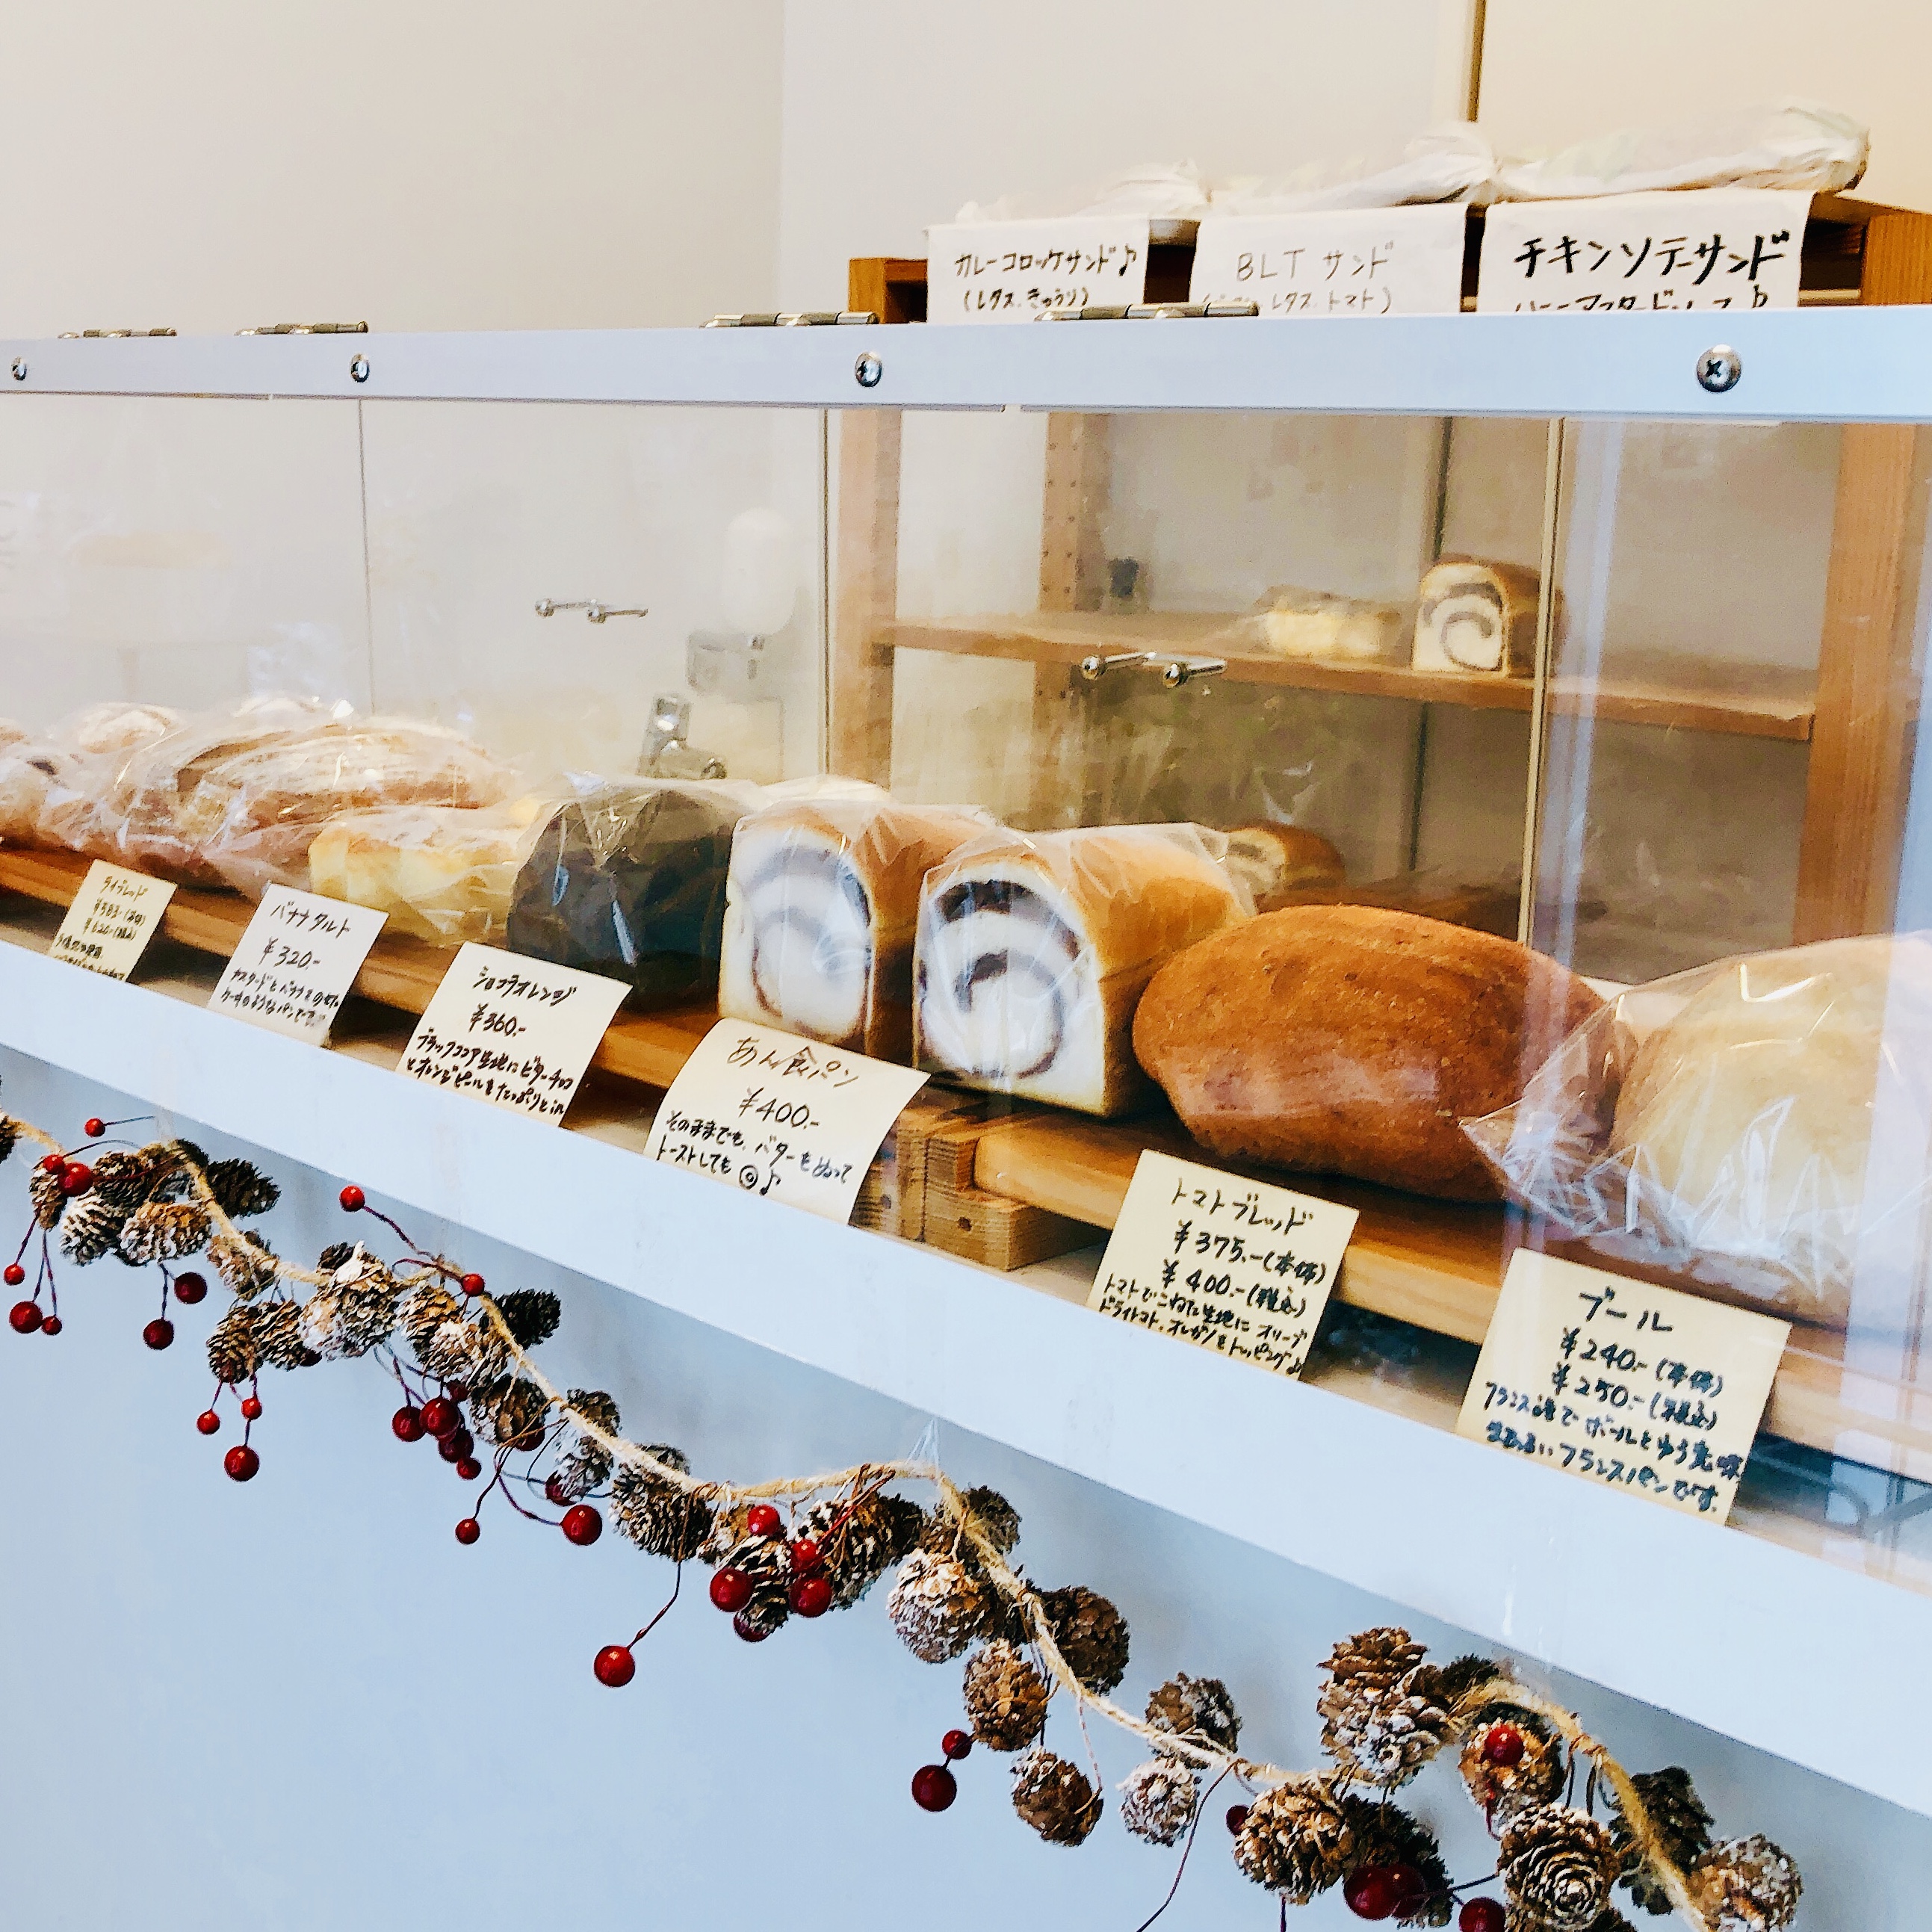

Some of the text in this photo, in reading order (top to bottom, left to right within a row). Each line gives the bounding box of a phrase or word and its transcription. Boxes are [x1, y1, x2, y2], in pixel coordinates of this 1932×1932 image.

[1236, 240, 1395, 282] BLT サンド
[726, 1036, 860, 1089] あん食パン
[1579, 1285, 1674, 1332] ブール
